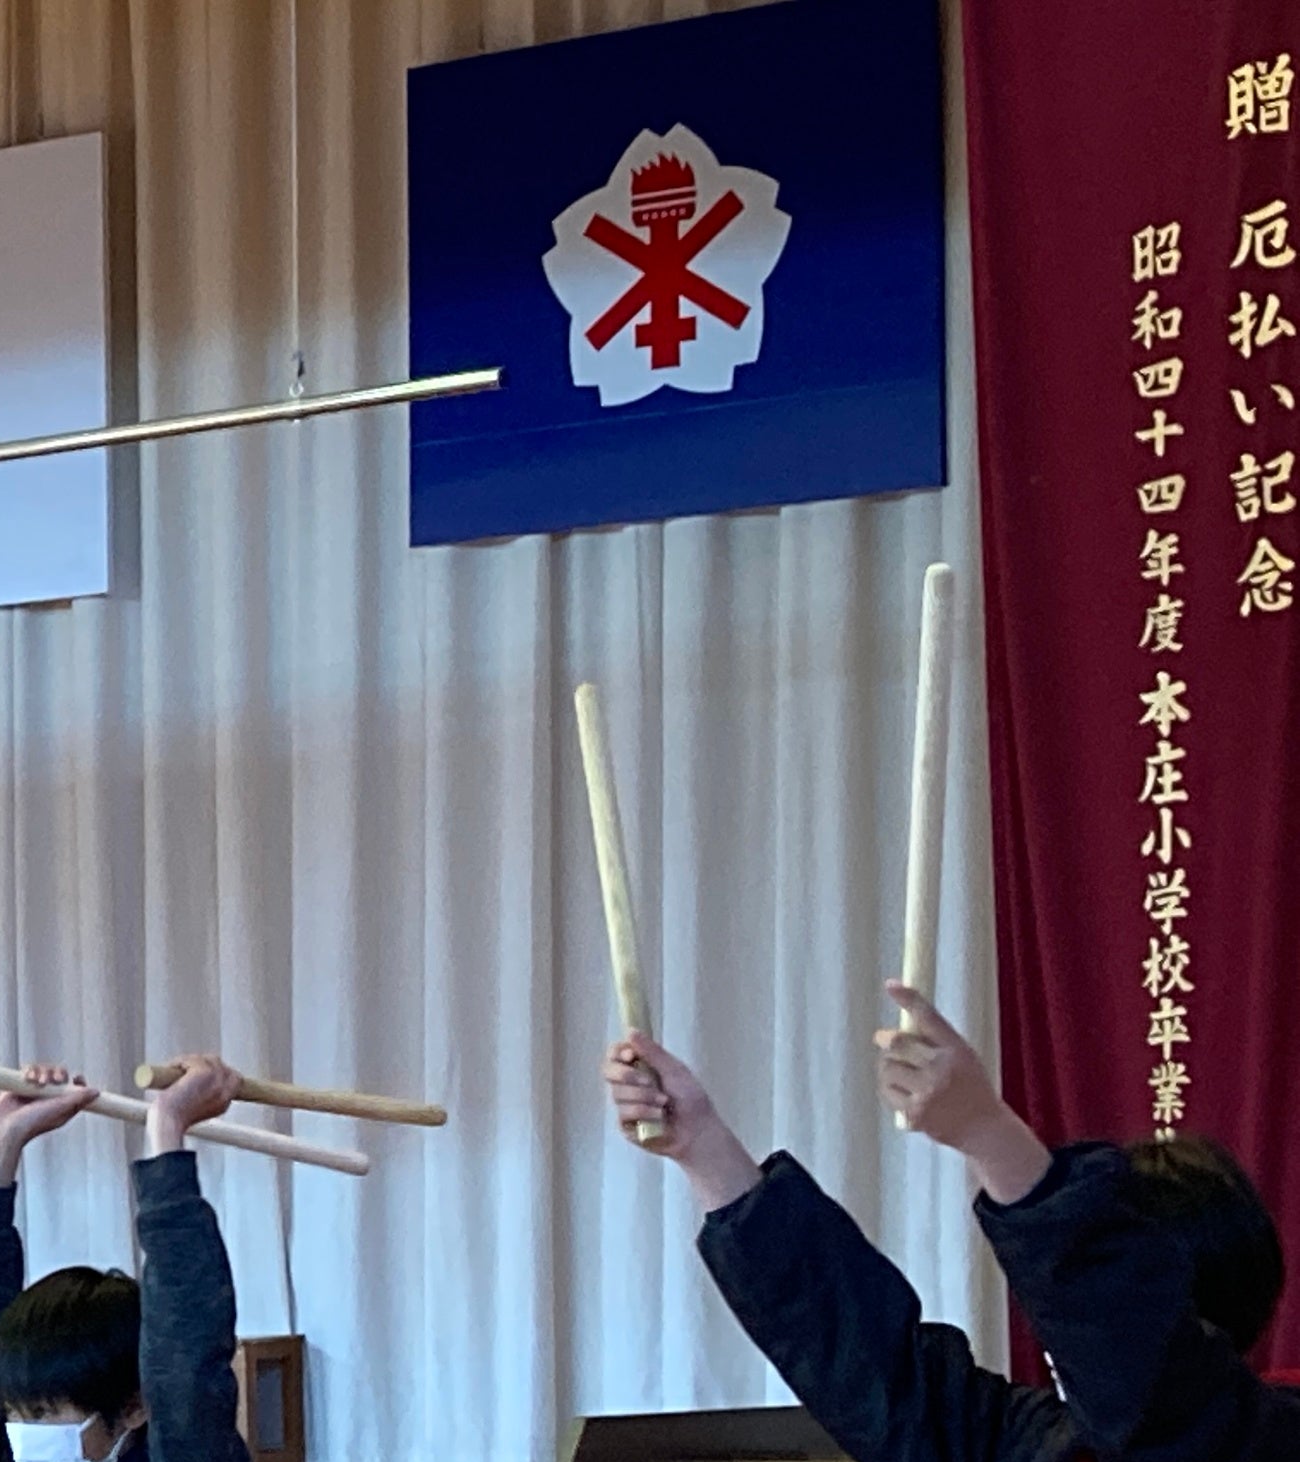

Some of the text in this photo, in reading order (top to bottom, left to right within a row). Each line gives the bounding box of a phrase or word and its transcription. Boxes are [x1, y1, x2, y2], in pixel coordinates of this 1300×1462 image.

[1224, 52, 1298, 618] 贈 厄払い記念
